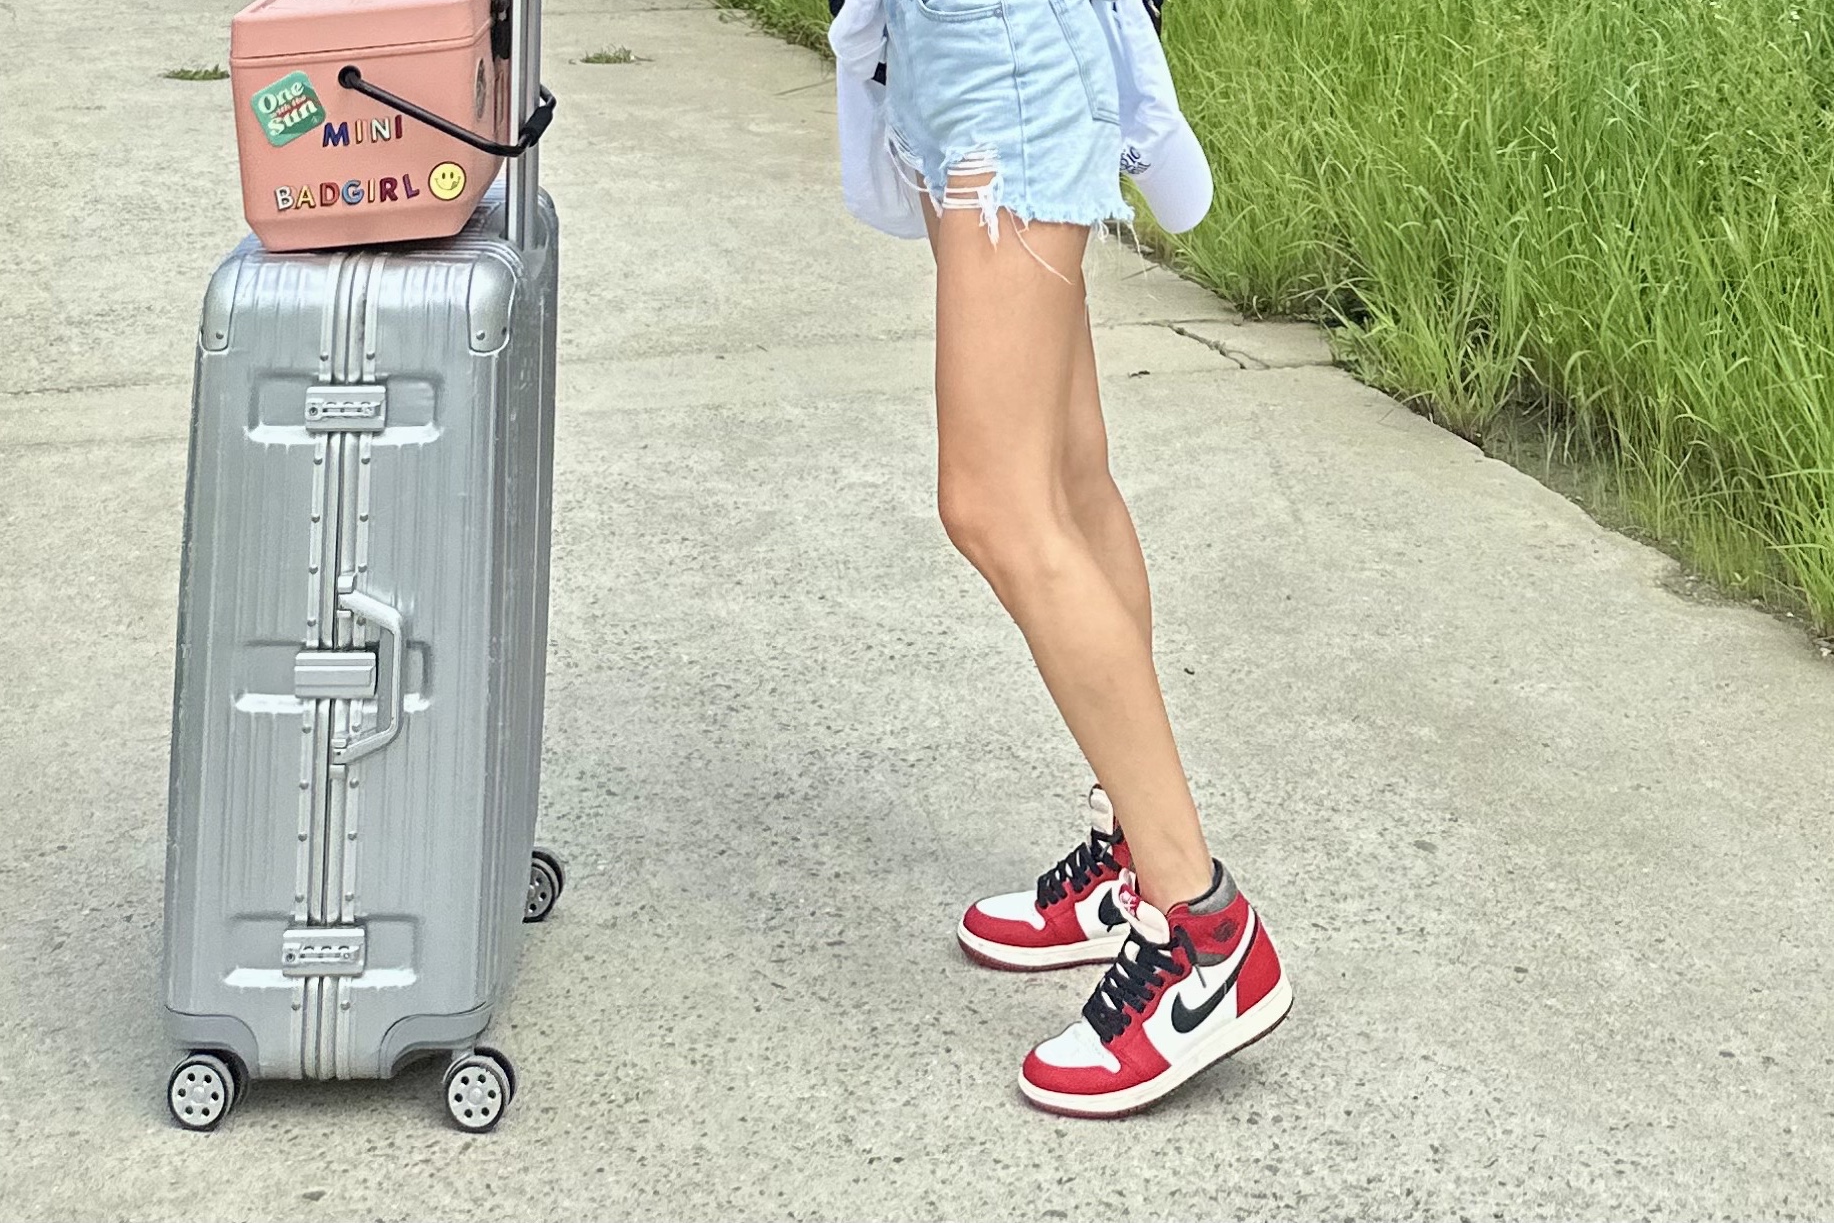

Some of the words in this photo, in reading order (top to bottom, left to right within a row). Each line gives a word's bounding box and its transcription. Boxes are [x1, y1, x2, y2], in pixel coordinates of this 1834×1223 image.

[258, 81, 304, 114] One
[268, 100, 318, 136] Sun
[322, 114, 403, 147] MINI
[274, 173, 420, 211] BADGIRL
